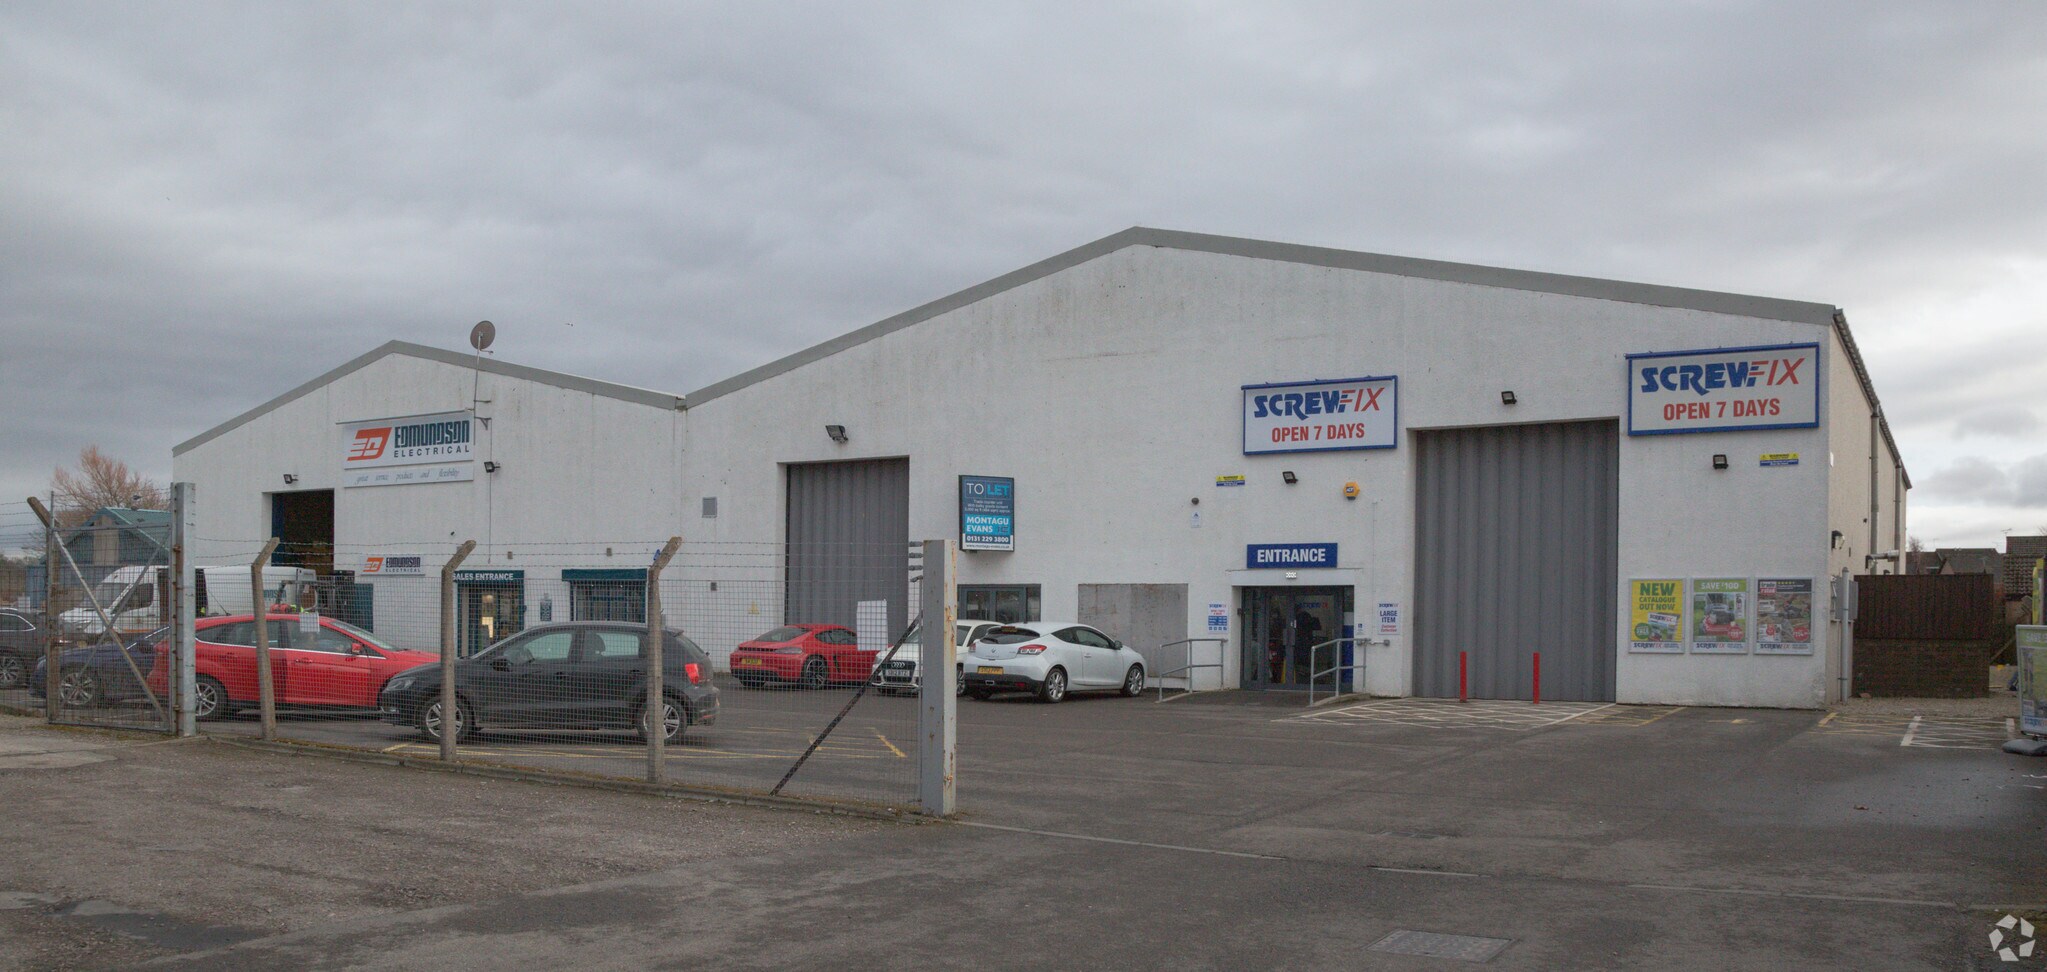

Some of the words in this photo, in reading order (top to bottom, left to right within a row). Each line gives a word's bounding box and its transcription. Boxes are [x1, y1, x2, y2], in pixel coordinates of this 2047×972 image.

[1641, 358, 1805, 396] SCREWFIX
[1254, 387, 1385, 420] SCREWFIX
[1663, 403, 1710, 420] OPEN
[1716, 402, 1726, 418] 7
[1733, 398, 1780, 417] DAYS
[394, 420, 470, 448] EDMUNDSON
[1271, 426, 1309, 442] OPEN
[1313, 425, 1323, 440] 7
[1327, 423, 1365, 440] DAYS
[394, 445, 470, 458] ELECTRICAL
[966, 483, 984, 494] TO
[987, 484, 1009, 497] LET
[966, 516, 1009, 525] MONTAGU
[966, 525, 993, 533] EVANS
[386, 557, 421, 567] EDMUNDSON
[1257, 548, 1326, 562] ENTRANCE
[1640, 583, 1675, 596] NEW
